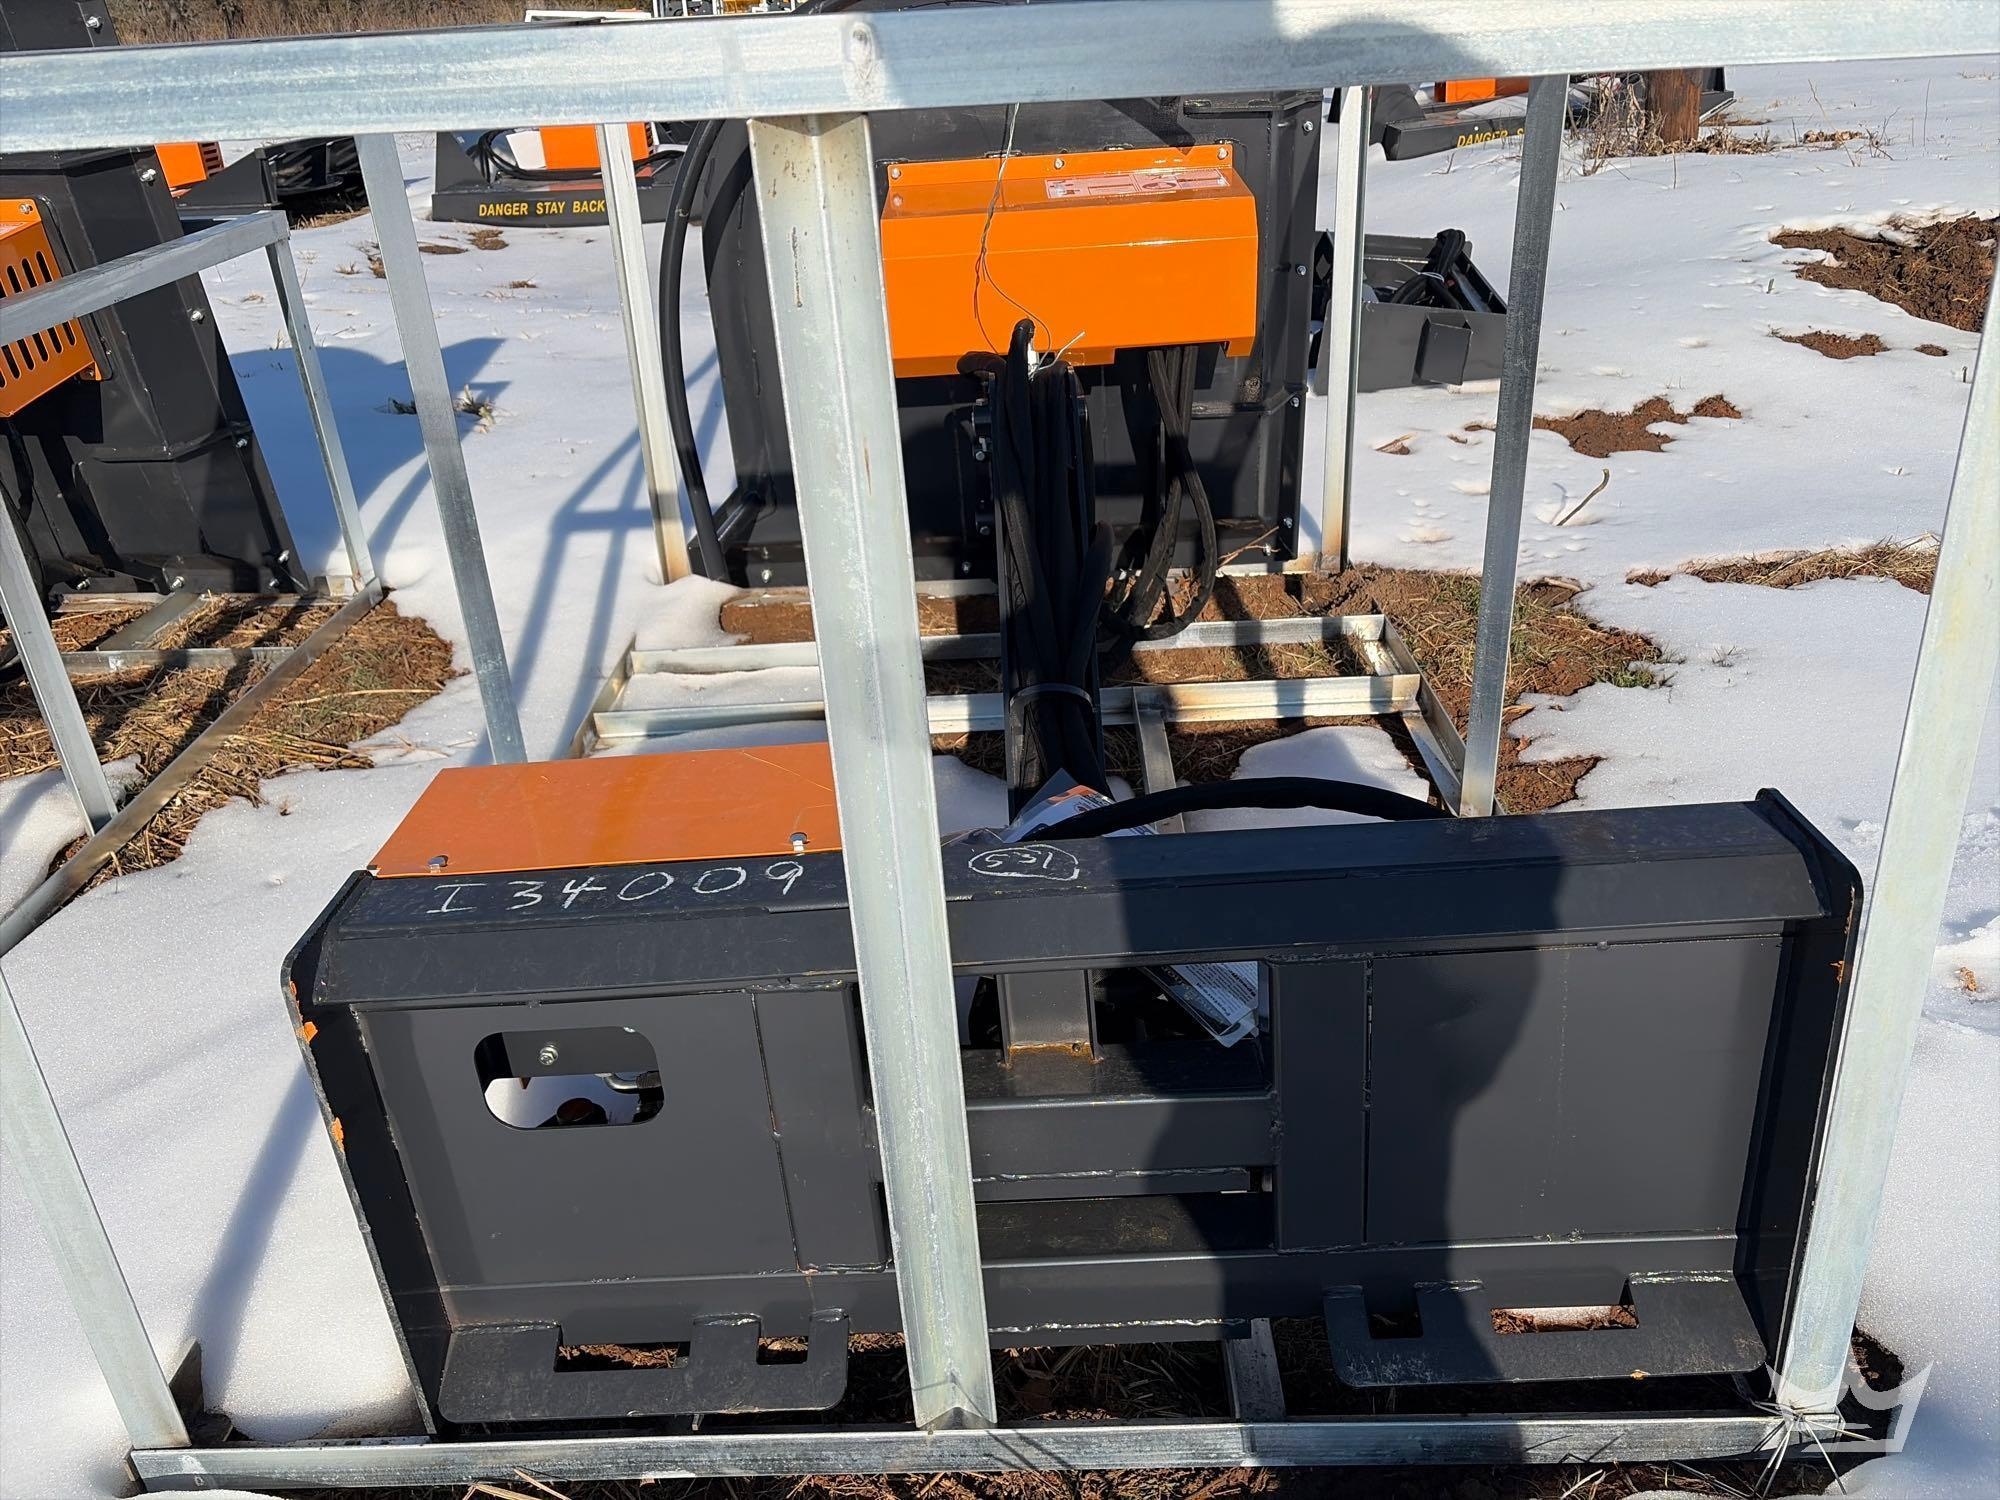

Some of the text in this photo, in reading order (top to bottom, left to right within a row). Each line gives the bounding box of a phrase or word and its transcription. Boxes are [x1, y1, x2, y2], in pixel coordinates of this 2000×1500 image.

[479, 200, 605, 217] DANGER STAY BACK
